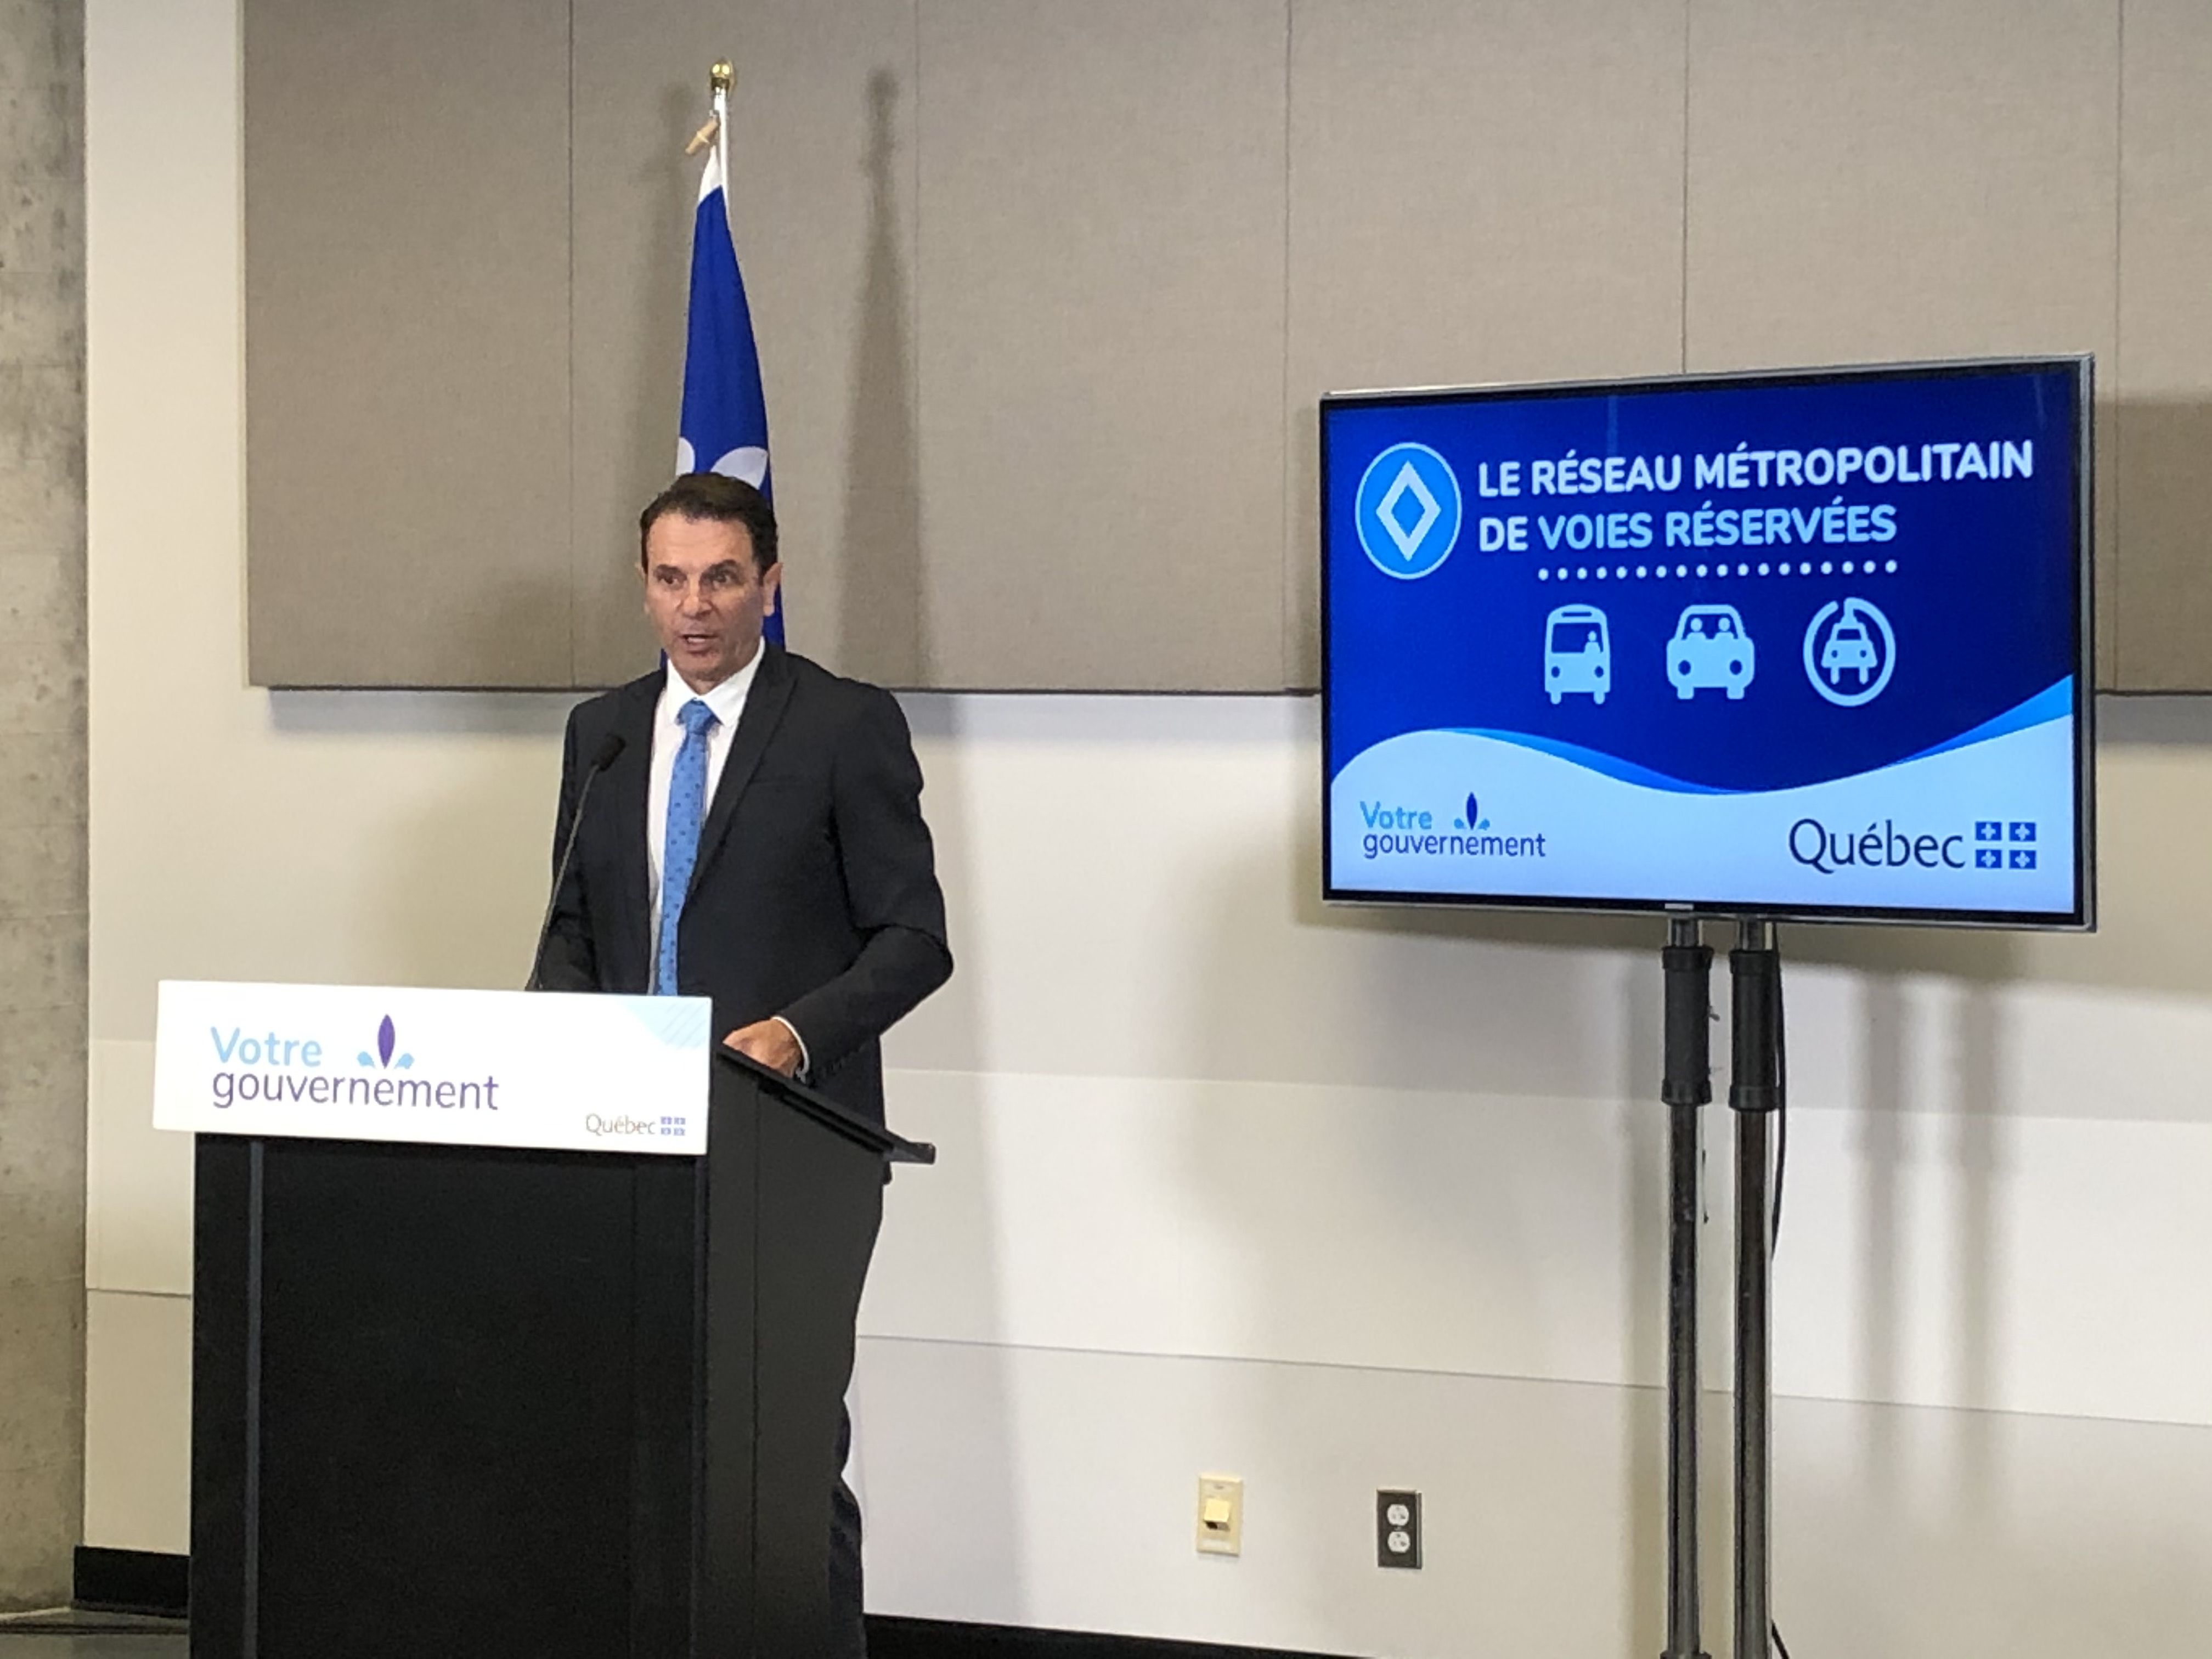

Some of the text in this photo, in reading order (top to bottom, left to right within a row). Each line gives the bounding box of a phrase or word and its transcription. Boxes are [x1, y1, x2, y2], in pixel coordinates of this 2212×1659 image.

[1478, 440, 2033, 498] LE RÉSEAU MÉTROPOLITAIN
[1479, 496, 1897, 551] DE VOIES RÉSERVÉES
[1359, 800, 1433, 830] Votre
[1363, 830, 1546, 859] gouvernement
[1788, 817, 1965, 874] Québec
[211, 1026, 322, 1066] Votre
[212, 1071, 499, 1111] gouvernement
[585, 1114, 656, 1137] Québec
